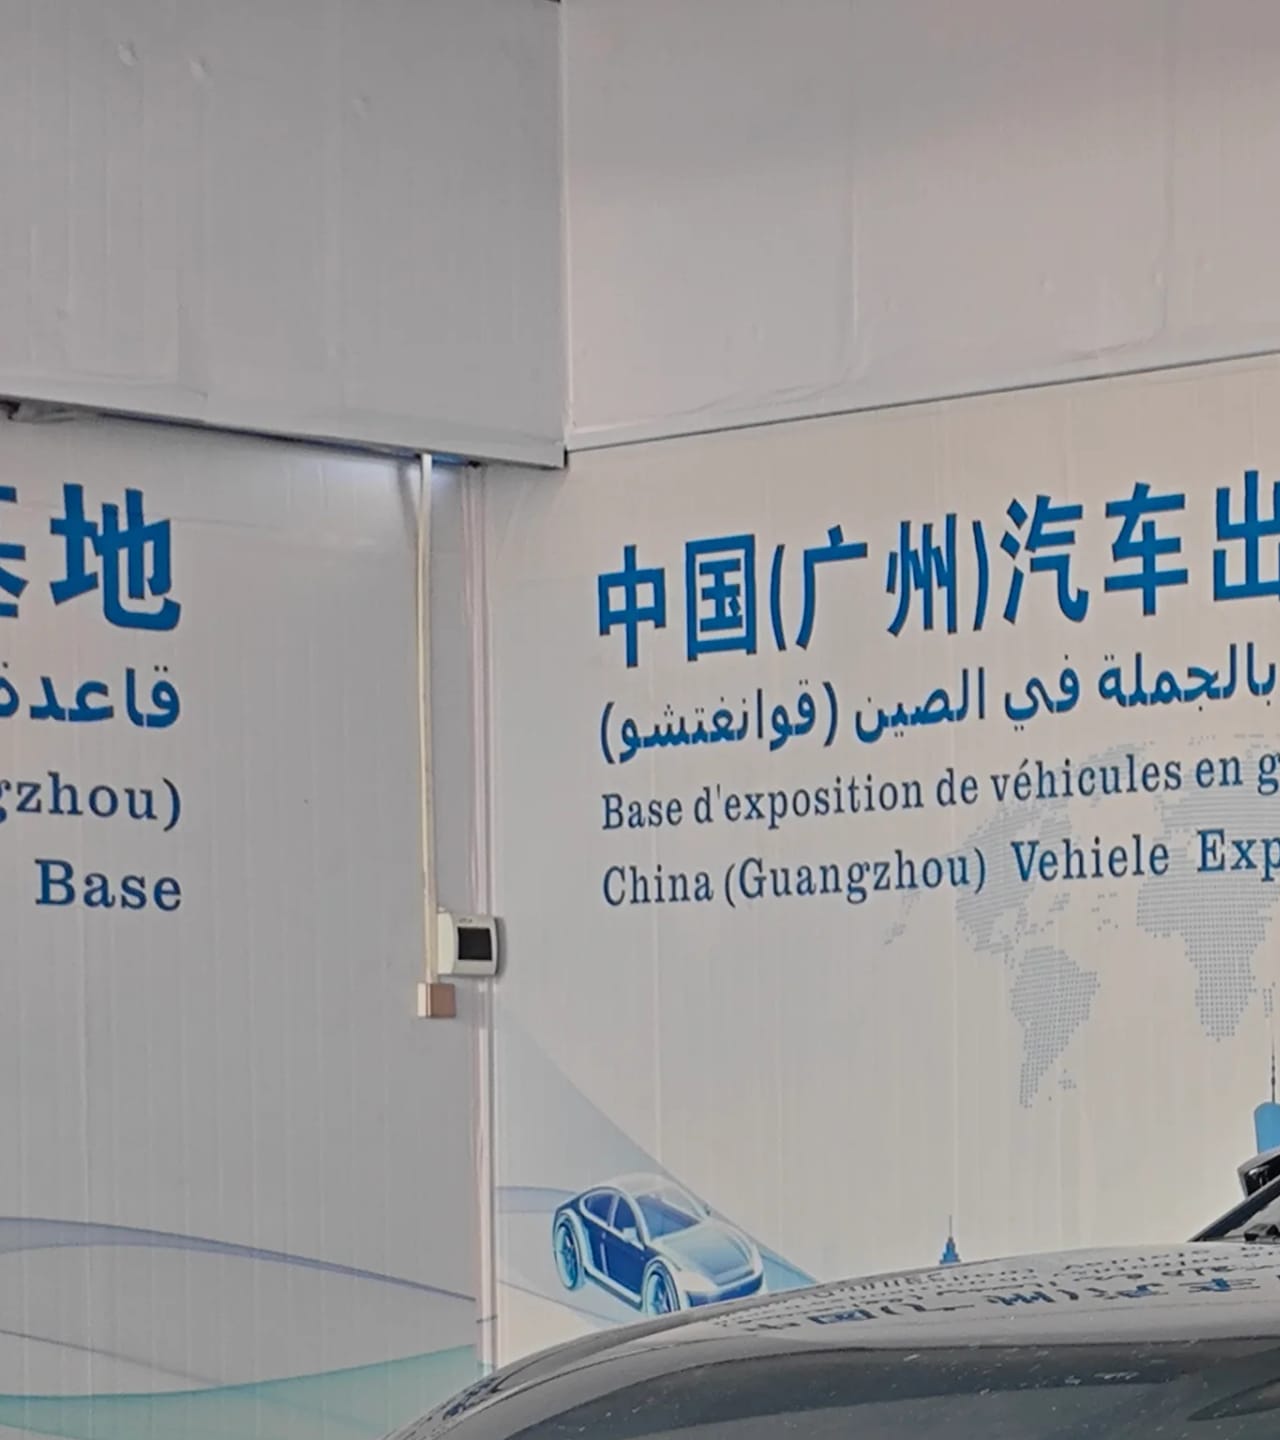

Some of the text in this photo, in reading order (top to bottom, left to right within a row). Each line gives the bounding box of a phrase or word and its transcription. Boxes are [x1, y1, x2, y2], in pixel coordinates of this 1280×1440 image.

[854, 666, 986, 745] الصين
[1003, 653, 1081, 733] في
[1097, 641, 1277, 709] بالجملة
[600, 792, 684, 831] Base
[692, 772, 925, 831] d'exposition
[935, 766, 979, 808] de
[989, 752, 1183, 803] véhicules
[1194, 755, 1244, 790] en
[33, 858, 182, 913] Base
[602, 863, 715, 908] China
[723, 846, 987, 909] (Guangzhou)
[1009, 833, 1170, 883] Vehiele
